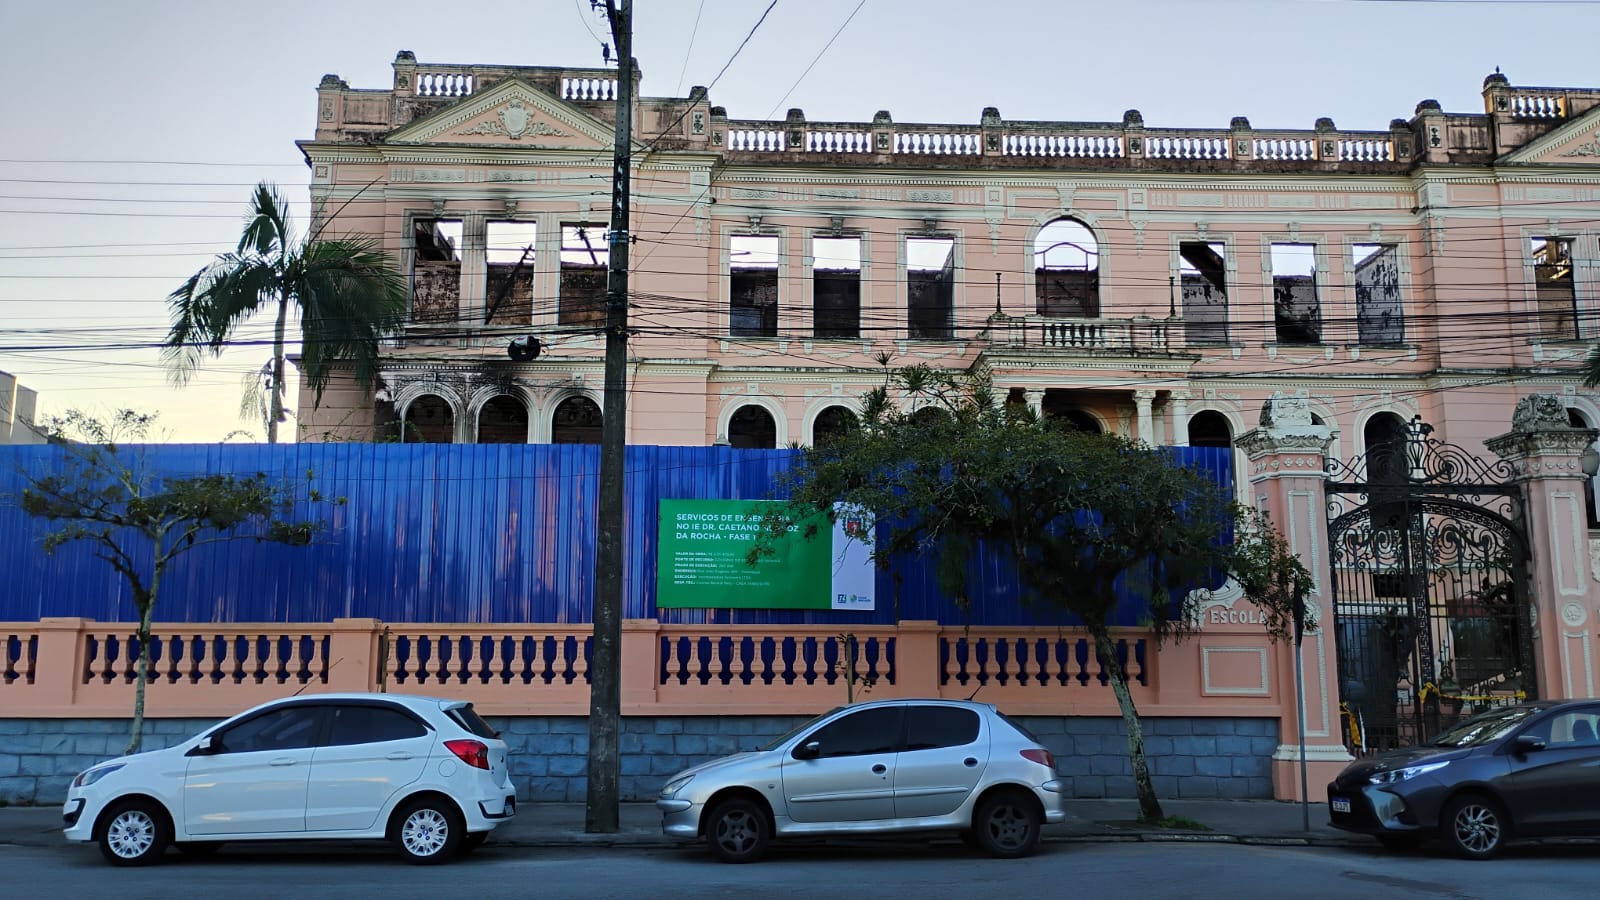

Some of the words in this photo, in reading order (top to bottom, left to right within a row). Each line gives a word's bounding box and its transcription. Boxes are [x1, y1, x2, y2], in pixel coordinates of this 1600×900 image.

[676, 513, 719, 522] SERVIÇOS
[721, 514, 733, 522] DE
[735, 514, 790, 522] ENGENRIA
[702, 523, 717, 531] DR.
[718, 524, 760, 532] CAETANO
[676, 532, 689, 540] DA
[690, 532, 721, 540] ROCHA
[729, 533, 751, 541] FASE
[1210, 610, 1267, 624] ESCOLA
